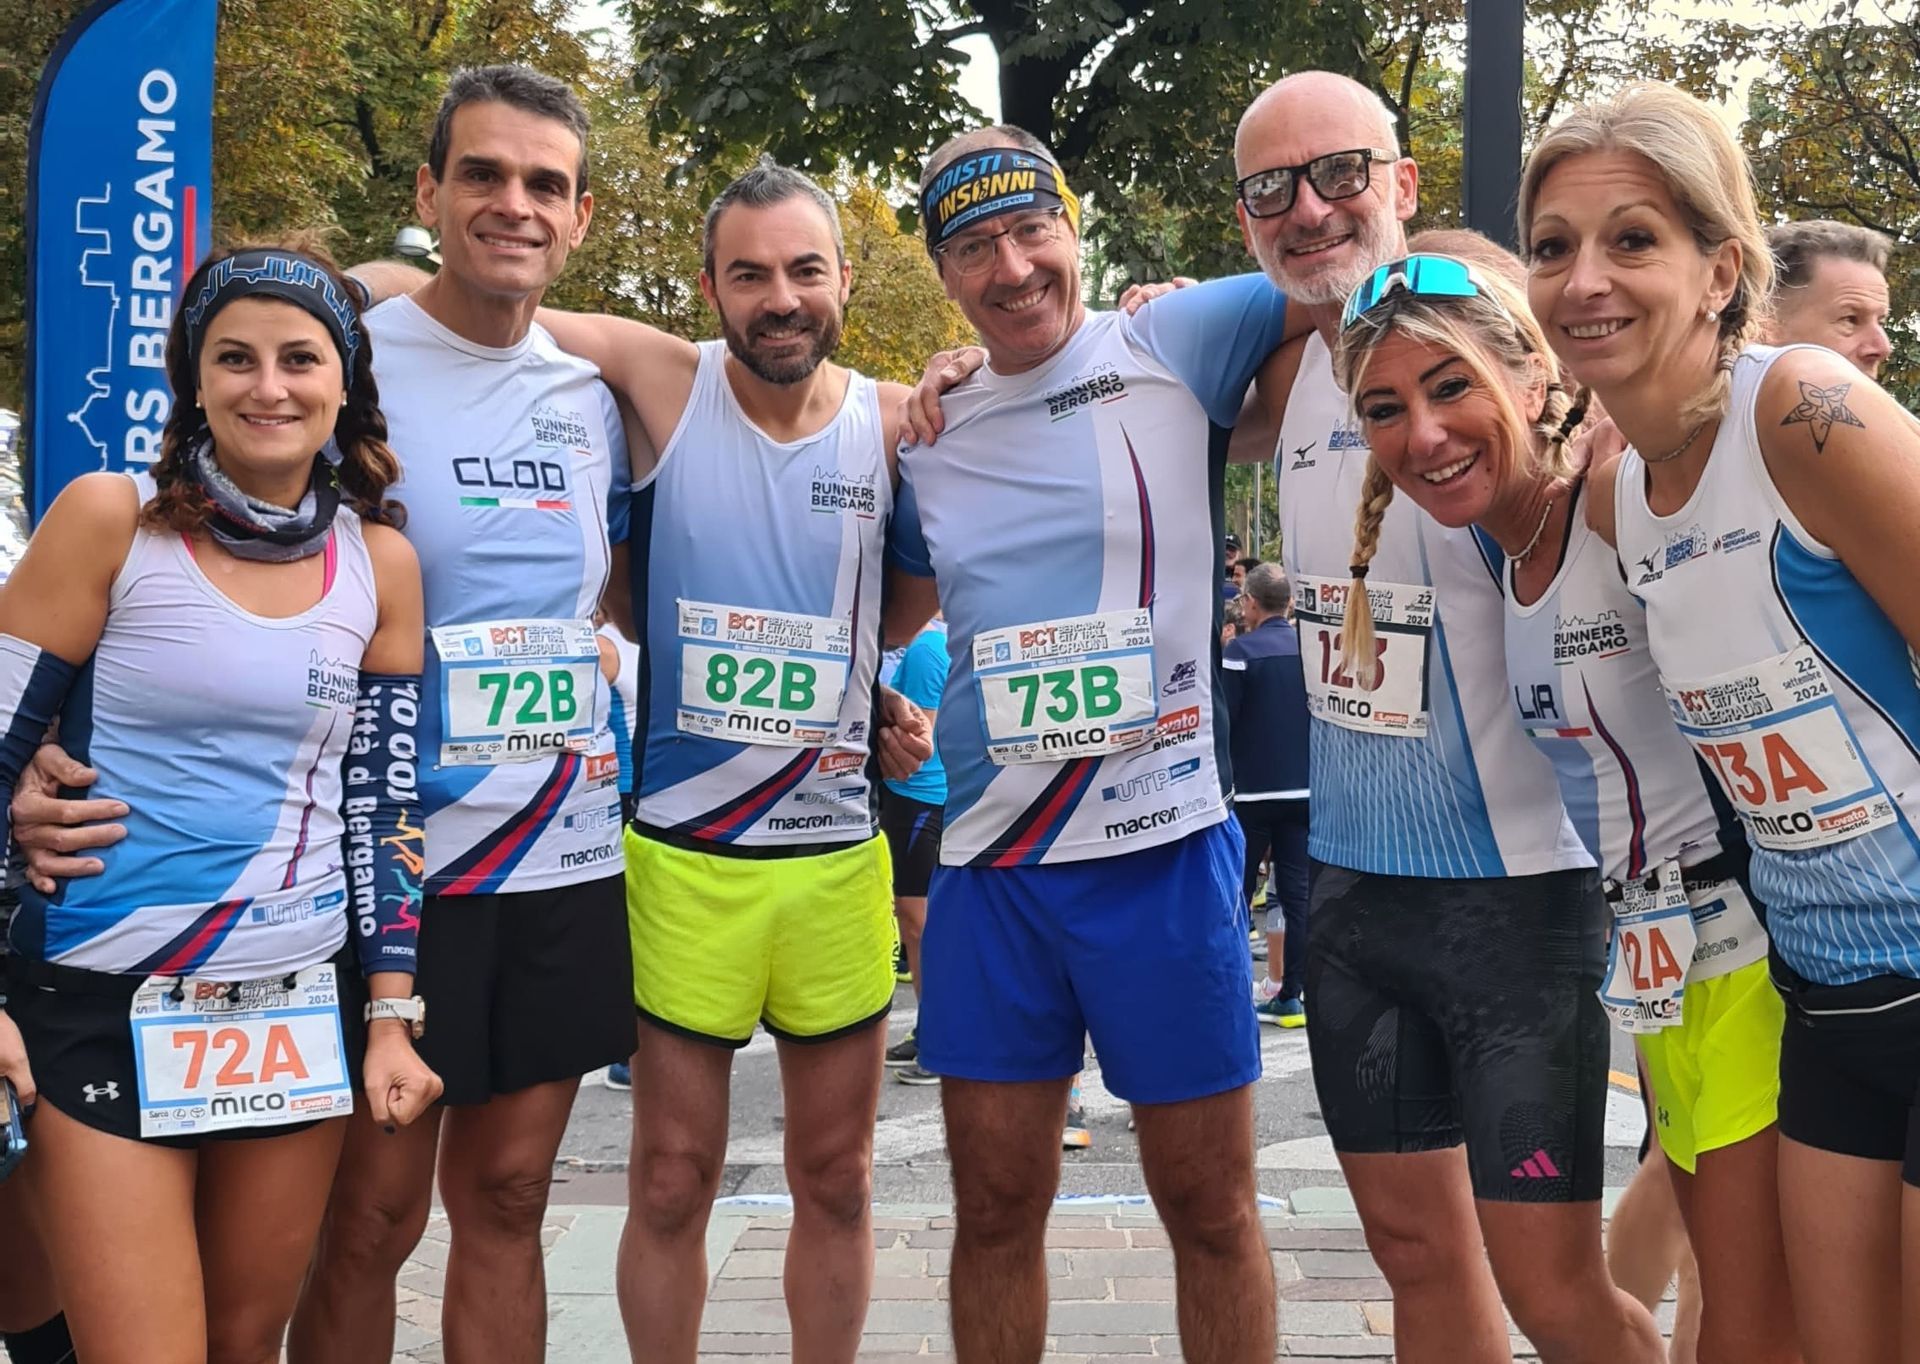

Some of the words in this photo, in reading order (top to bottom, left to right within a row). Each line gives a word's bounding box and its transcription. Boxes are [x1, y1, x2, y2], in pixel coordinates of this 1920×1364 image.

[129, 69, 178, 369] BERGAMO
[1044, 371, 1120, 405] RUNNERS
[1050, 383, 1125, 416] BERGAMO
[123, 388, 170, 475] RS
[531, 417, 588, 437] RUNNERS
[535, 429, 590, 449] BERGAMO
[811, 482, 875, 500] RUNNERS
[811, 494, 875, 513] BERGAMO
[1418, 594, 1432, 605] 22
[728, 612, 768, 633] BCT
[1134, 616, 1148, 626] 22
[1406, 615, 1429, 625] 2024
[489, 626, 528, 645] BCT
[579, 628, 592, 637] 22
[838, 626, 850, 637] 22
[1019, 627, 1058, 648] BCT
[1126, 636, 1150, 646] 2024
[1554, 624, 1625, 646] RUNNERS
[827, 644, 850, 653] 2024
[1554, 636, 1628, 659] BERGAMO
[1795, 658, 1816, 673] 22
[308, 668, 357, 692] RUNNE
[706, 653, 817, 711] 82B
[1782, 671, 1822, 690] settembre
[478, 670, 576, 726] 72B
[1008, 666, 1122, 728] 73B
[1793, 682, 1828, 702] 2024
[1153, 730, 1197, 751] electric
[828, 755, 862, 770] Lovato
[1116, 768, 1169, 802] UTP
[575, 806, 608, 832] UTP
[769, 814, 833, 830] macron
[1105, 805, 1181, 839] macron
[1826, 809, 1867, 828] Lovato
[346, 796, 378, 937] Bergamo
[561, 844, 614, 869] macron
[1669, 870, 1680, 881] 22
[1665, 893, 1686, 906] 2024
[266, 897, 314, 926] UTP
[1619, 928, 1683, 990] 2A
[318, 973, 333, 983] 22
[195, 982, 229, 1000] BC
[308, 994, 334, 1004] 2024
[172, 1024, 310, 1089] 72A
